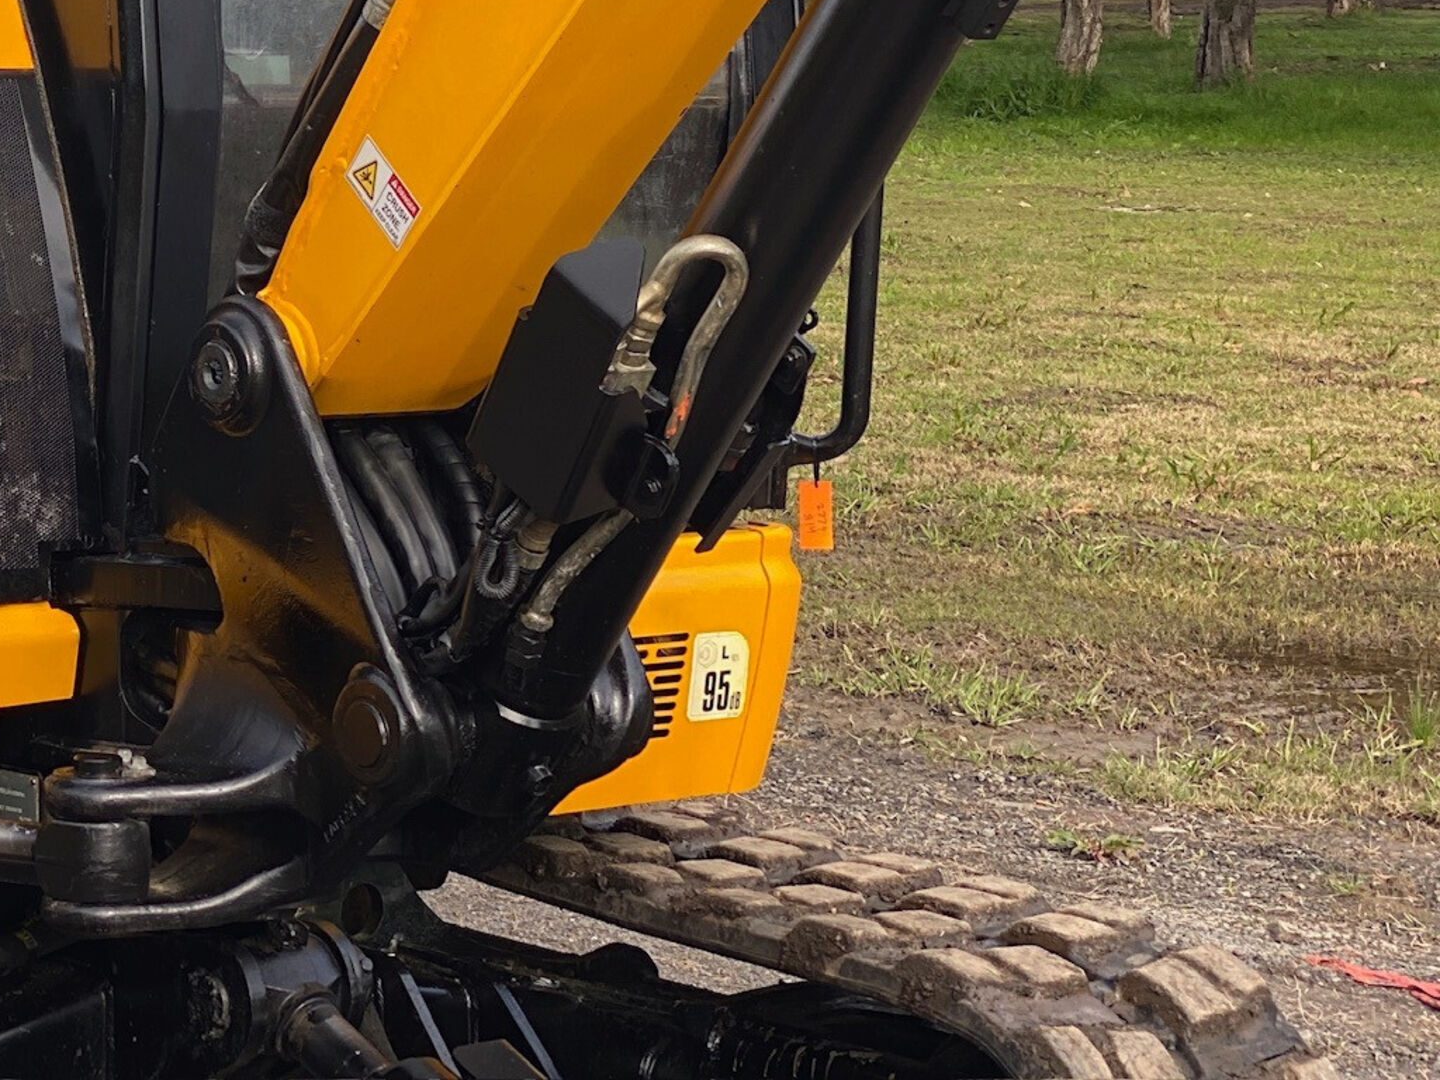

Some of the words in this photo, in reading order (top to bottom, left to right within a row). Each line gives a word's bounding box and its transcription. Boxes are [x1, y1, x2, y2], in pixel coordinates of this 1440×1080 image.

[385, 191, 409, 224] CRUSH
[722, 645, 729, 659] L
[702, 670, 731, 712] 95
